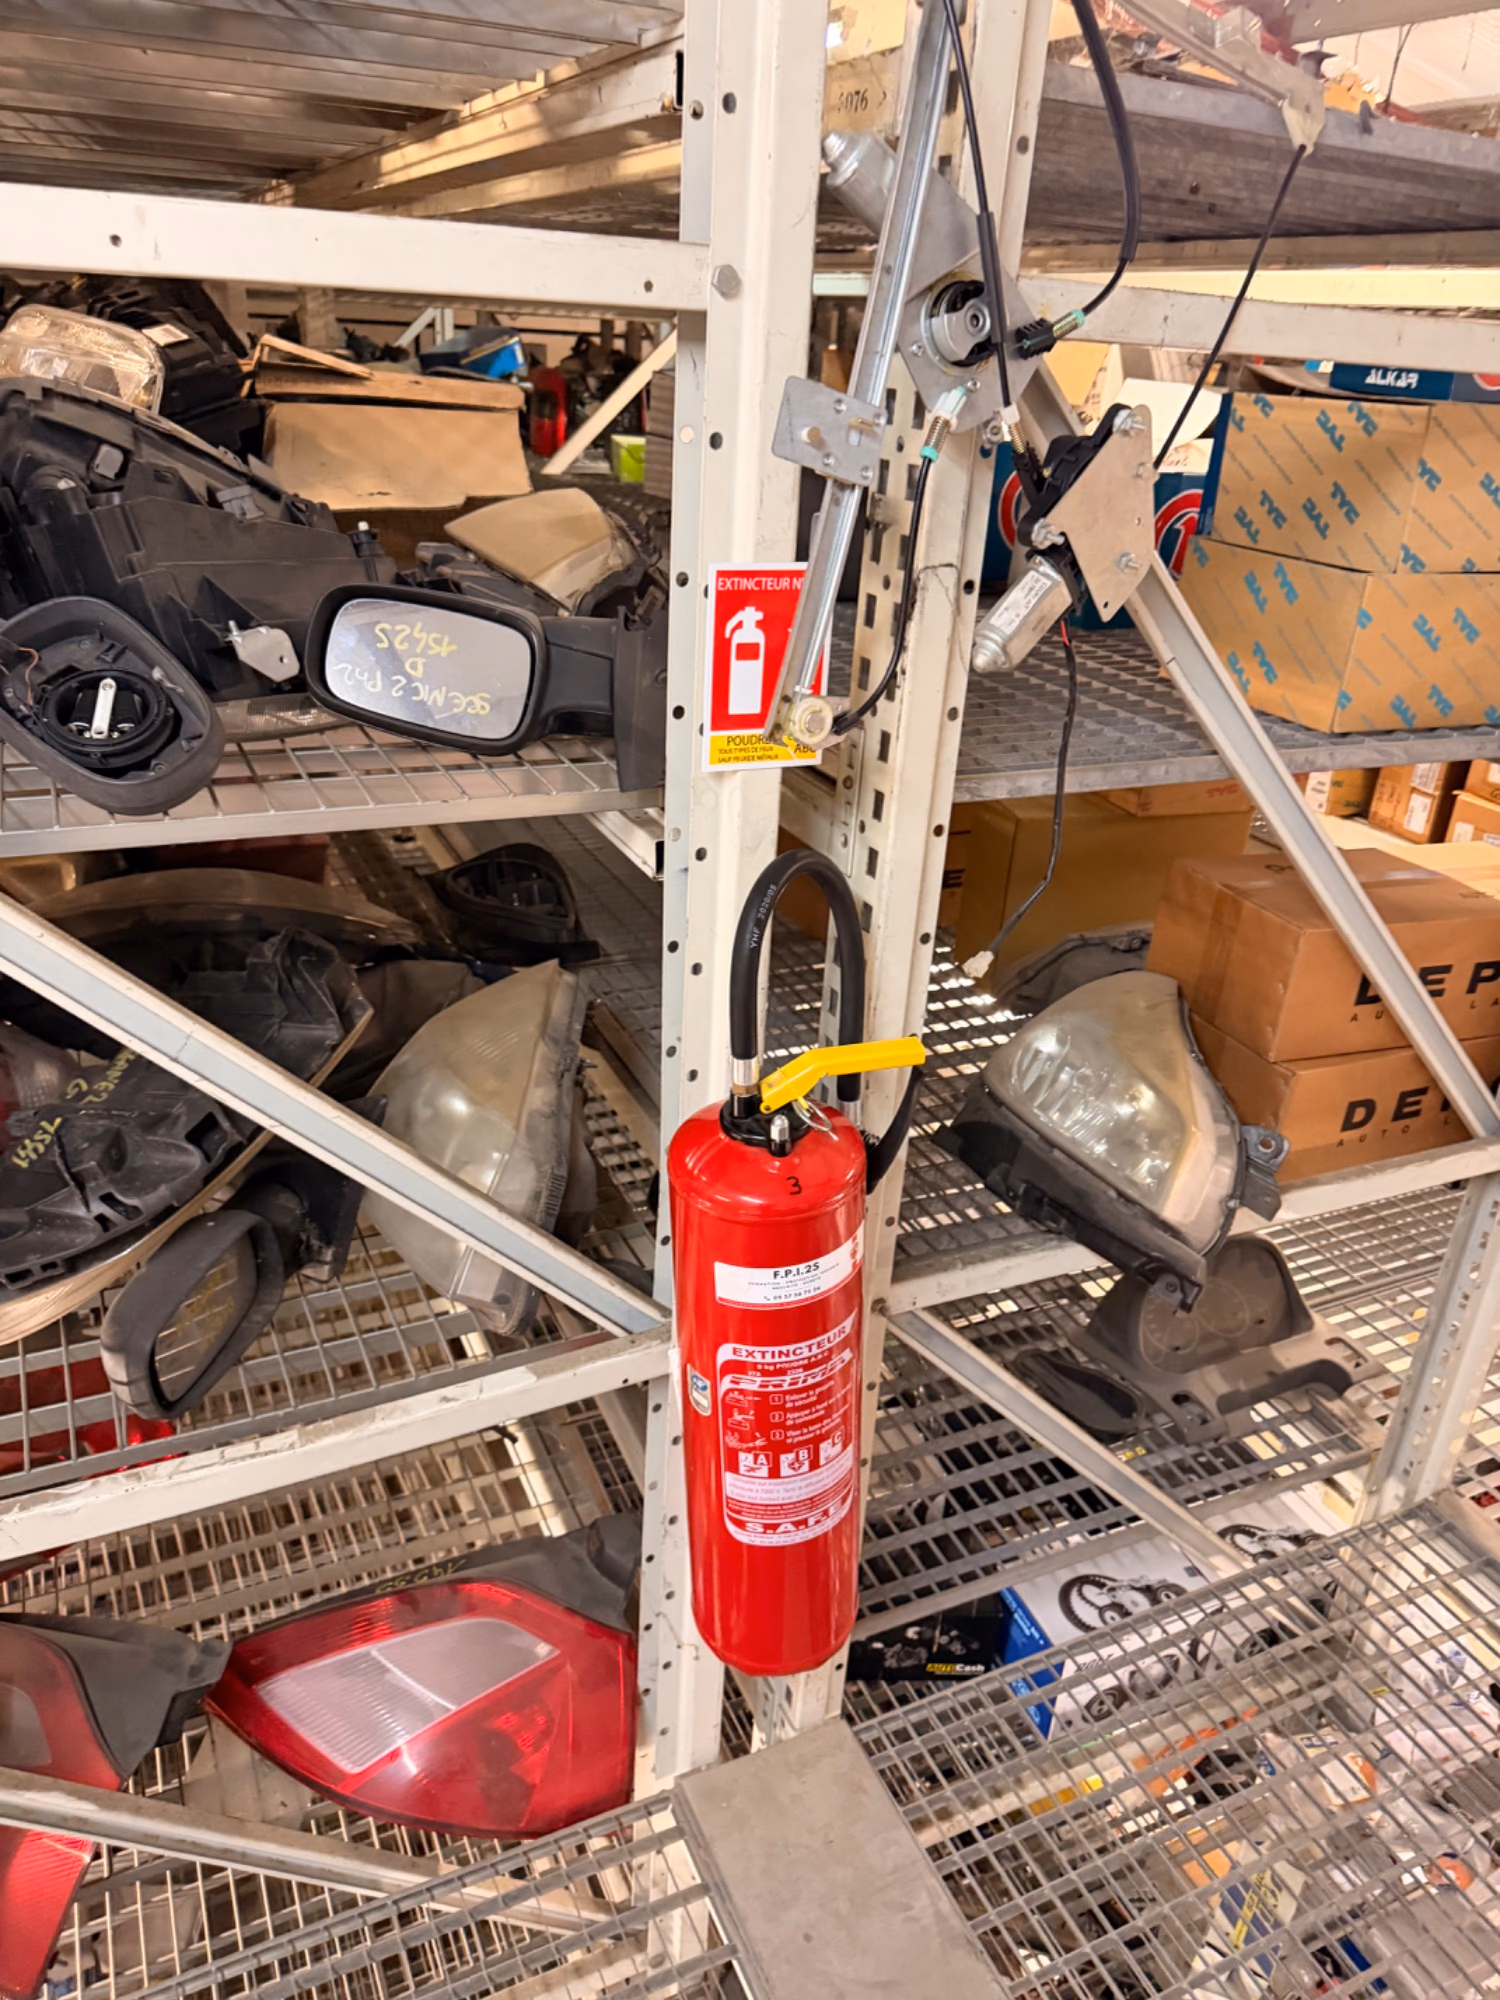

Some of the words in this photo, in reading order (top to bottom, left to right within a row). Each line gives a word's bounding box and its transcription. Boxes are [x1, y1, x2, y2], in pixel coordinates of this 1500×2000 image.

[1364, 367, 1420, 389] ALKAR
[1253, 395, 1275, 419] YC
[1316, 408, 1346, 454] TYC
[1259, 489, 1288, 530] TYC
[1302, 497, 1330, 541] TYC
[1331, 480, 1361, 525] TYC
[1233, 506, 1260, 545] TYC
[717, 577, 790, 591] EXTINCTEUR
[1244, 570, 1268, 615] TYC
[1274, 560, 1299, 606] TYC
[374, 622, 458, 658] 15425
[1413, 613, 1441, 653] TYC
[1452, 607, 1480, 644] TYC
[404, 656, 427, 679] D
[1227, 651, 1251, 694] TYC
[1252, 640, 1278, 685] TYC
[391, 675, 408, 698] 2
[1428, 683, 1454, 718] TYC
[1390, 694, 1417, 729] TYC
[1336, 1124, 1410, 1148] AUTO
[786, 1176, 802, 1195] 3
[731, 1325, 848, 1361] EXTINCTEUR
[756, 1453, 768, 1466] A
[799, 1449, 809, 1460] B
